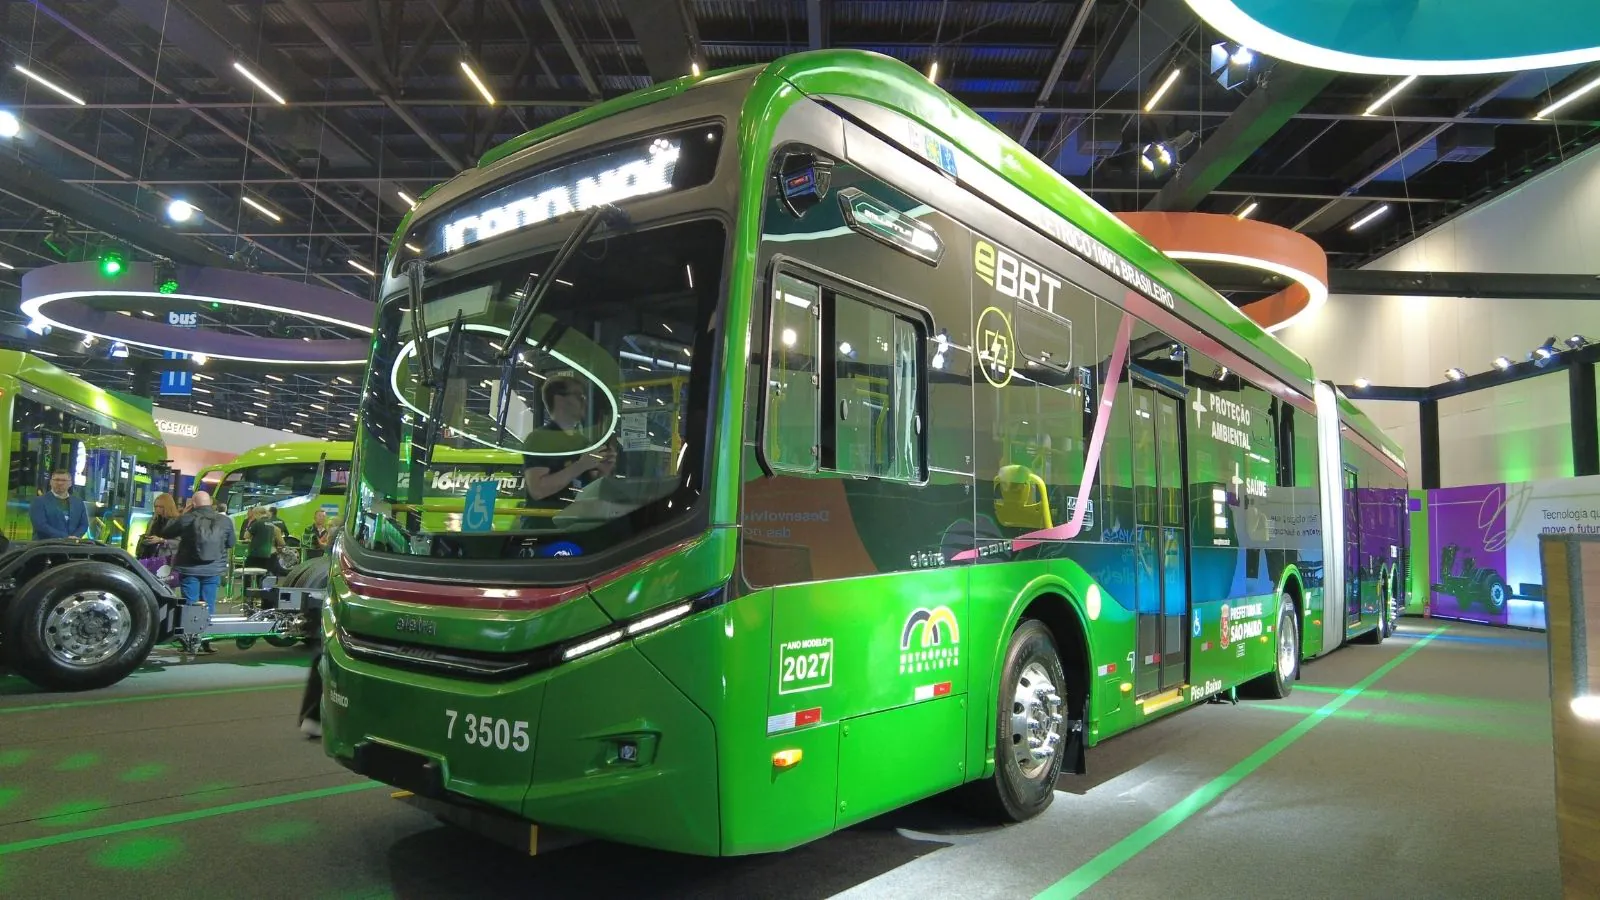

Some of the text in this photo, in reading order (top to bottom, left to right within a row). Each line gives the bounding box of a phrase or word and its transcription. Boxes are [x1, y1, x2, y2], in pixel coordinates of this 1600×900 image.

[1120, 260, 1175, 309] BRASILEIRO
[1209, 393, 1251, 427] PROTEÇÃO
[1211, 421, 1251, 450] AMBIENTAL
[1246, 476, 1267, 497] SAÚDE
[1541, 508, 1588, 521] Tecnologia
[1542, 526, 1566, 534] move
[1230, 619, 1262, 642] SÃO PAULO
[787, 637, 828, 650] ANO MODELO
[783, 652, 830, 682] 2027
[1191, 678, 1222, 701] Piso Baixo
[445, 709, 530, 752] 7 3505
